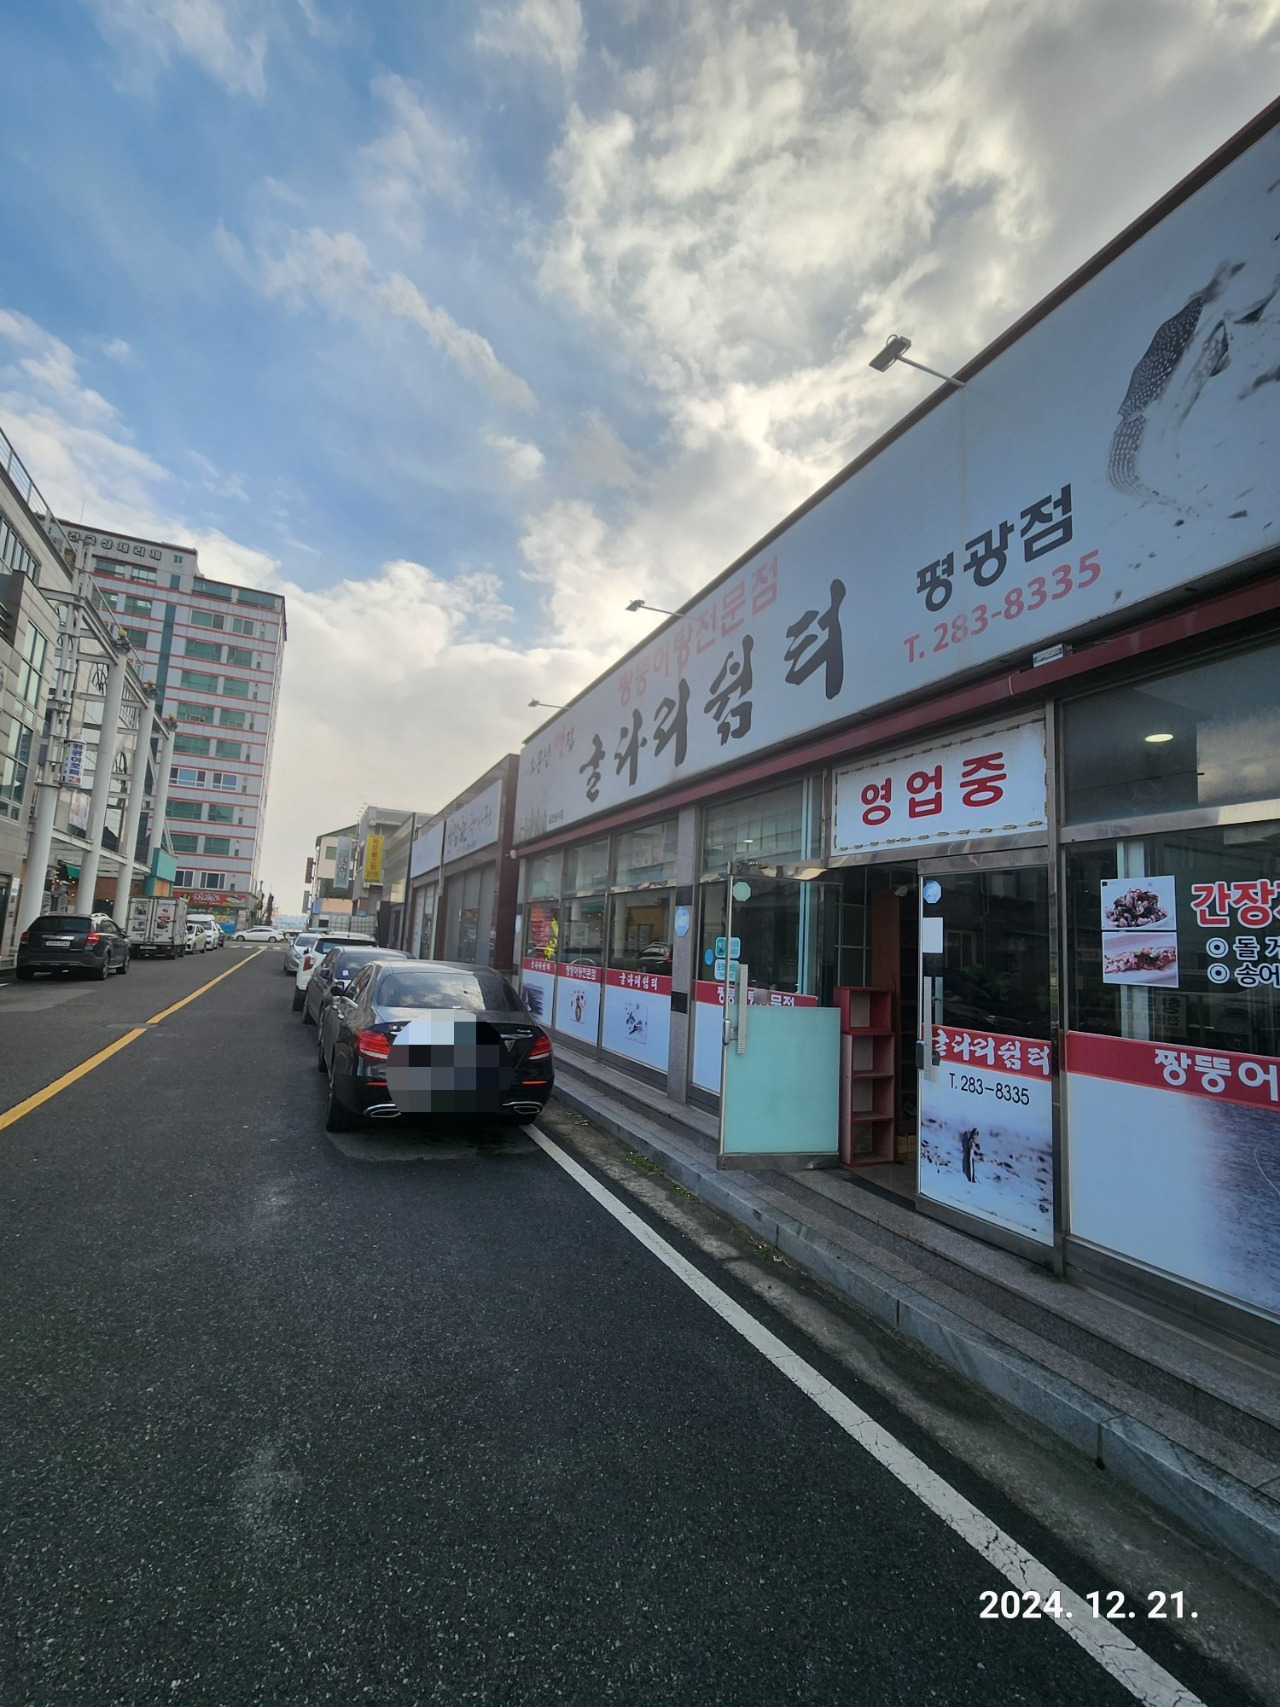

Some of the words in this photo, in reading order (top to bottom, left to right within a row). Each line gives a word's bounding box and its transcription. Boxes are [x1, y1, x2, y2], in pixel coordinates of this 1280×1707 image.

[916, 482, 1074, 613] 평광점
[618, 552, 780, 708] 짱뚱어탕전문점
[903, 633, 926, 664] T.
[932, 548, 1102, 654] 283-8335
[578, 577, 847, 804] 굴다리쉼터
[860, 751, 1008, 827] 영업중
[1190, 879, 1280, 929] 간장
[932, 1029, 1050, 1076] 굴다리쉼터
[948, 1072, 958, 1090] T.
[960, 1075, 1031, 1106] 283-8335
[1154, 1048, 1280, 1102] 짱뚱어
